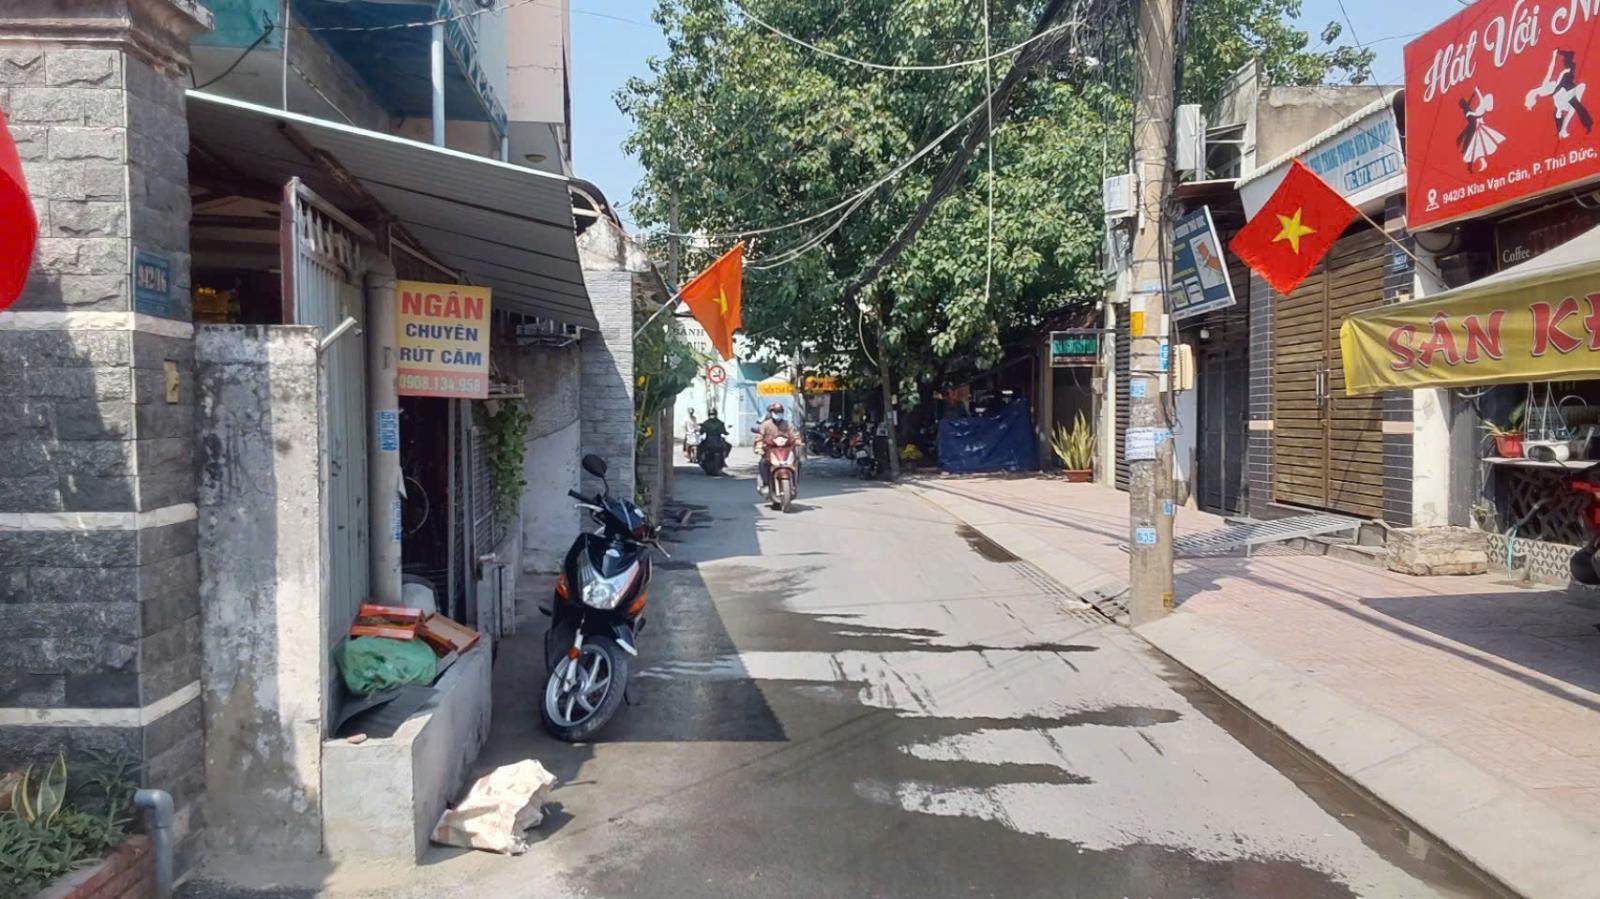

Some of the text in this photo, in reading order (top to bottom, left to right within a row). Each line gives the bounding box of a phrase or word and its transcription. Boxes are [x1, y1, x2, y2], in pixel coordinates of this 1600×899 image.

[1424, 0, 1600, 102] Hát Với N
[1467, 183, 1485, 197] Kha
[1487, 176, 1506, 191] Vạn
[1533, 162, 1543, 175] P.
[1544, 153, 1567, 170] Thủ
[1568, 147, 1598, 164] Đức,
[1502, 245, 1531, 263] Coffee
[401, 290, 484, 321] NGÂN
[405, 322, 479, 342] CHUYÊN
[1386, 309, 1506, 371] SÂN
[400, 345, 435, 363] RÚT
